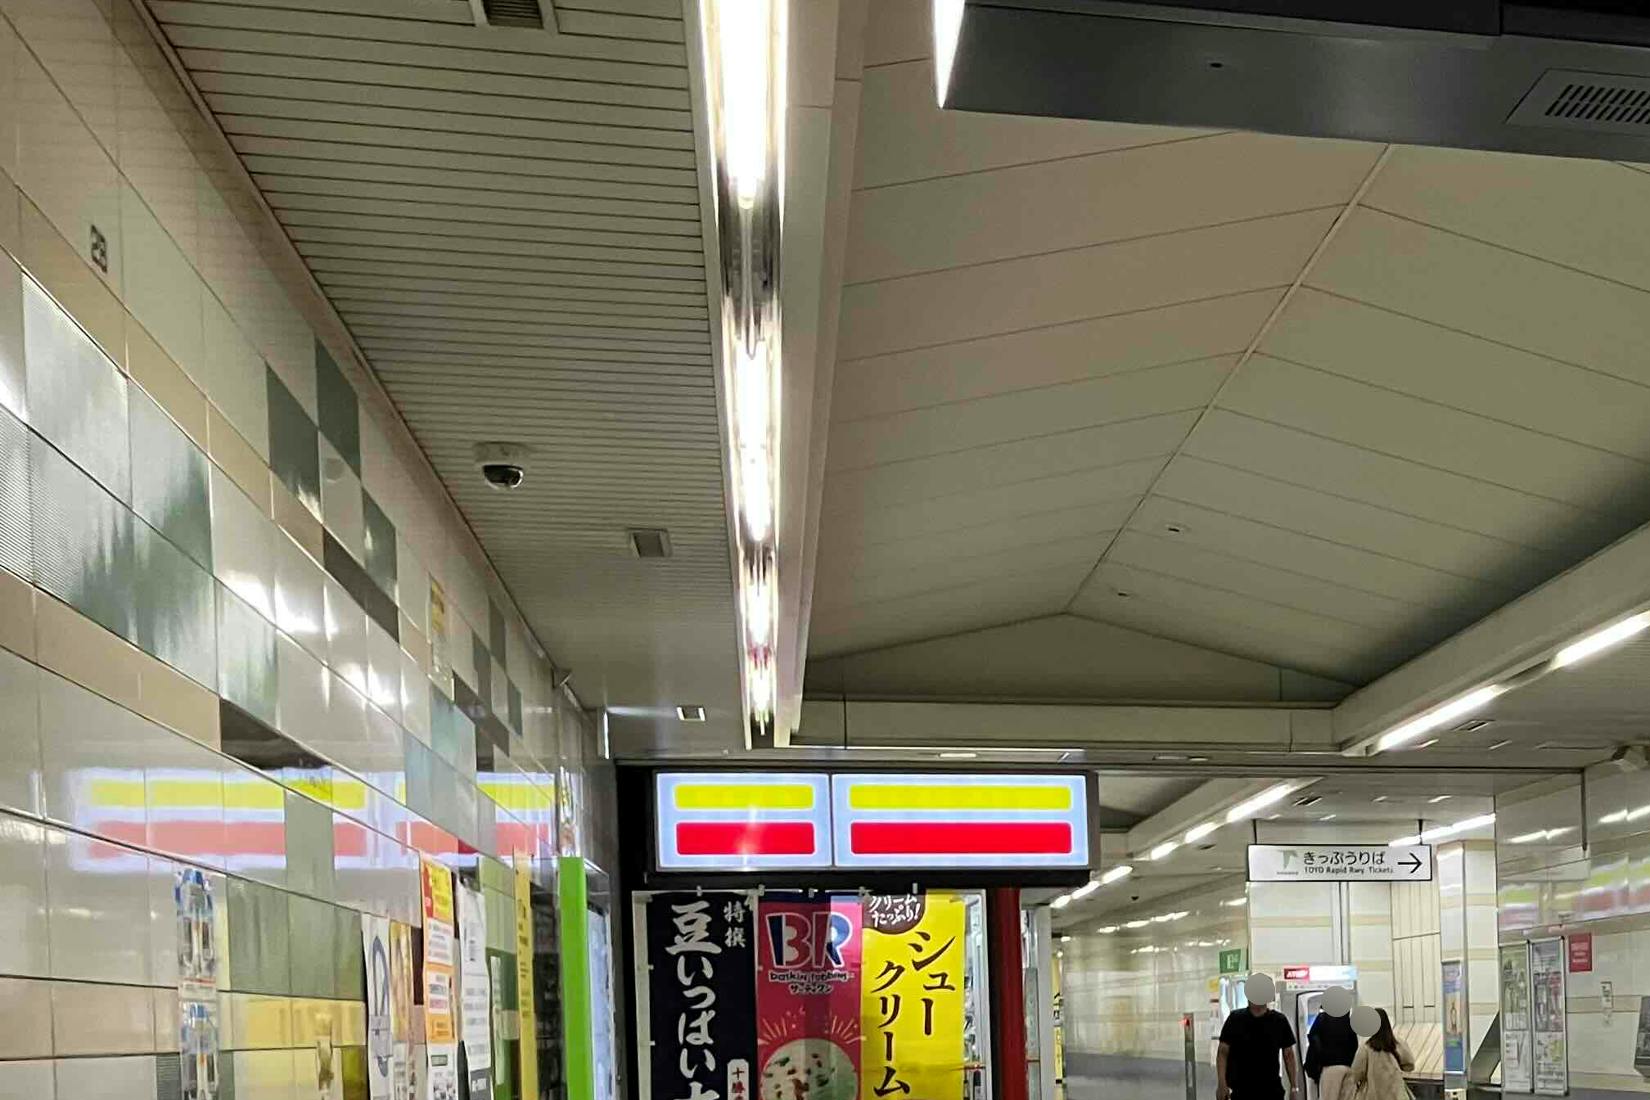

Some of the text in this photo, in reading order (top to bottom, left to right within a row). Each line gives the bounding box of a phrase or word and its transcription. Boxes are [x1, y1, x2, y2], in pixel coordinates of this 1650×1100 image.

[1304, 851, 1386, 865] きっぷうりば
[723, 900, 746, 948] 特撰
[869, 894, 917, 912] クリーム
[765, 911, 853, 969] BR
[908, 930, 956, 1036] シュー
[871, 960, 911, 1097] クリーム
